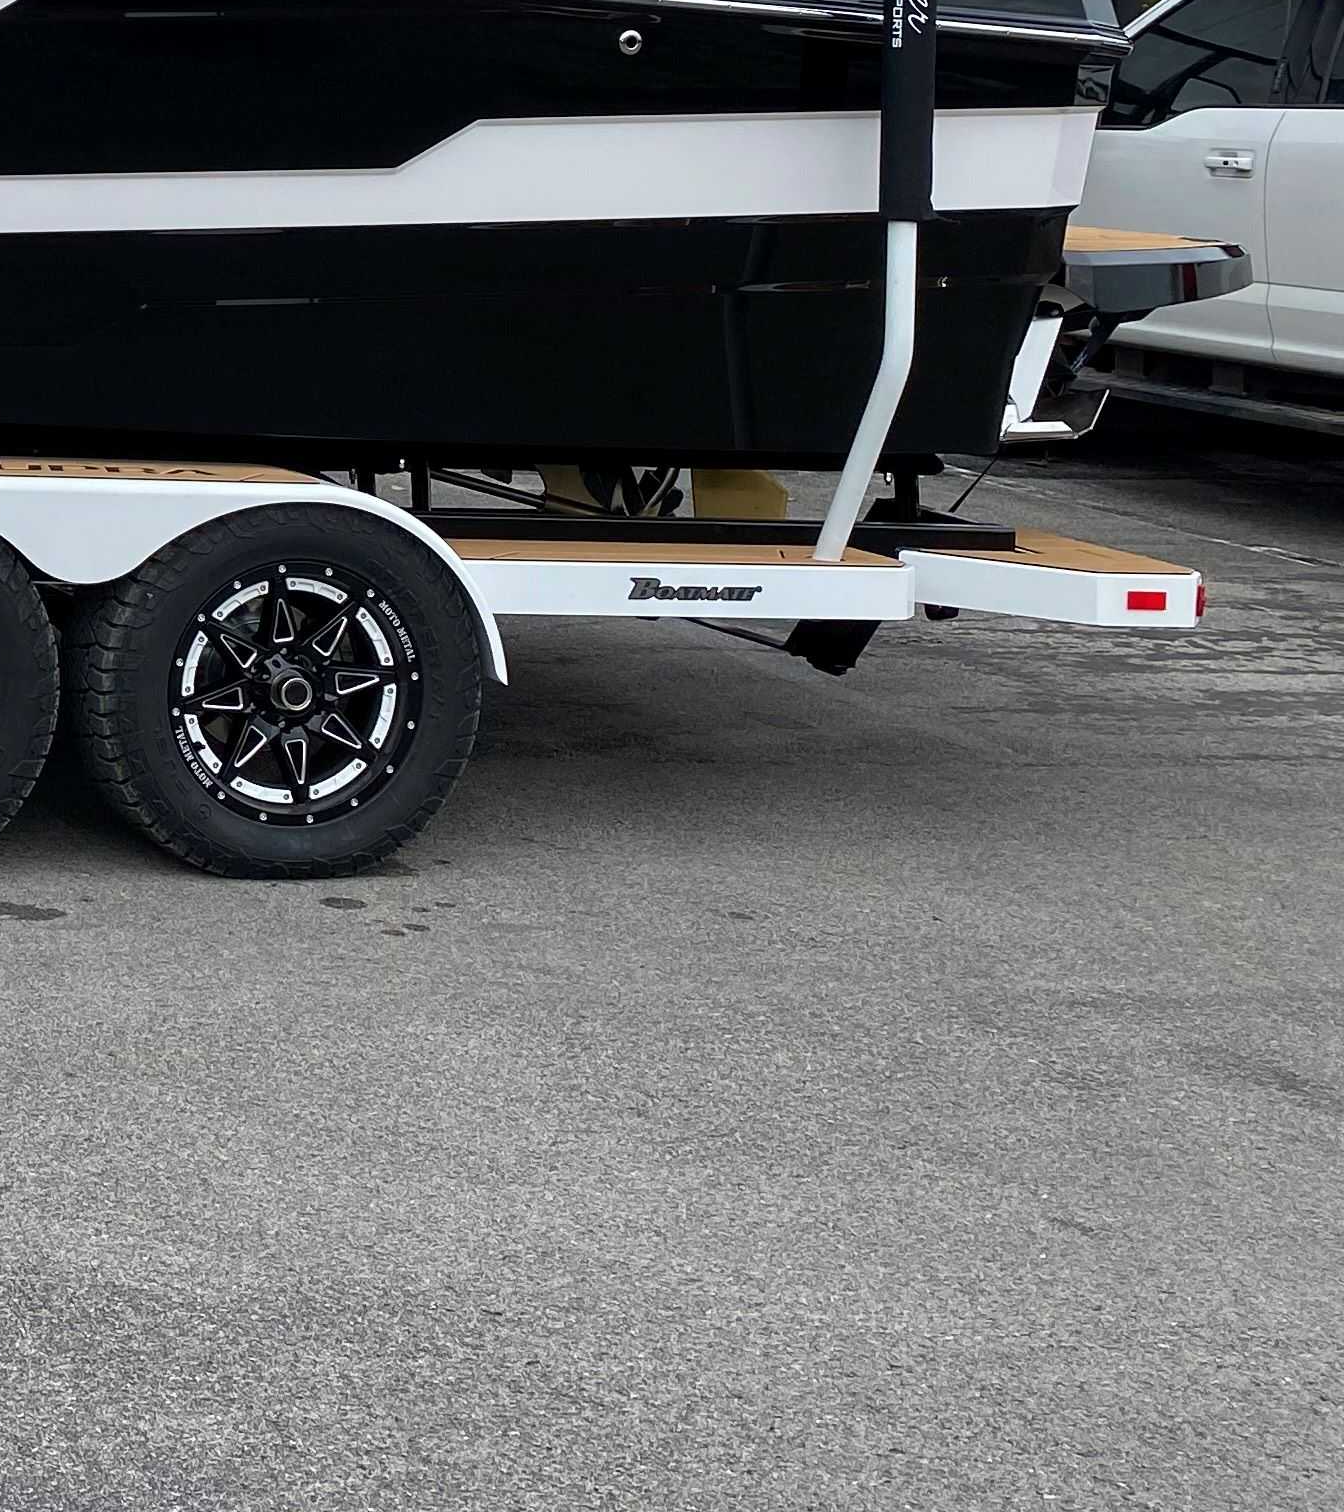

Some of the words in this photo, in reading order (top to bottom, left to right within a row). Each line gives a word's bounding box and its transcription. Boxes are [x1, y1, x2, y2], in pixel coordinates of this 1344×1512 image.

[628, 577, 762, 601] BOATMATE
[378, 600, 401, 627] MOTO
[396, 625, 416, 663] METAL
[175, 725, 195, 762] METAL
[190, 761, 214, 788] MOTO
